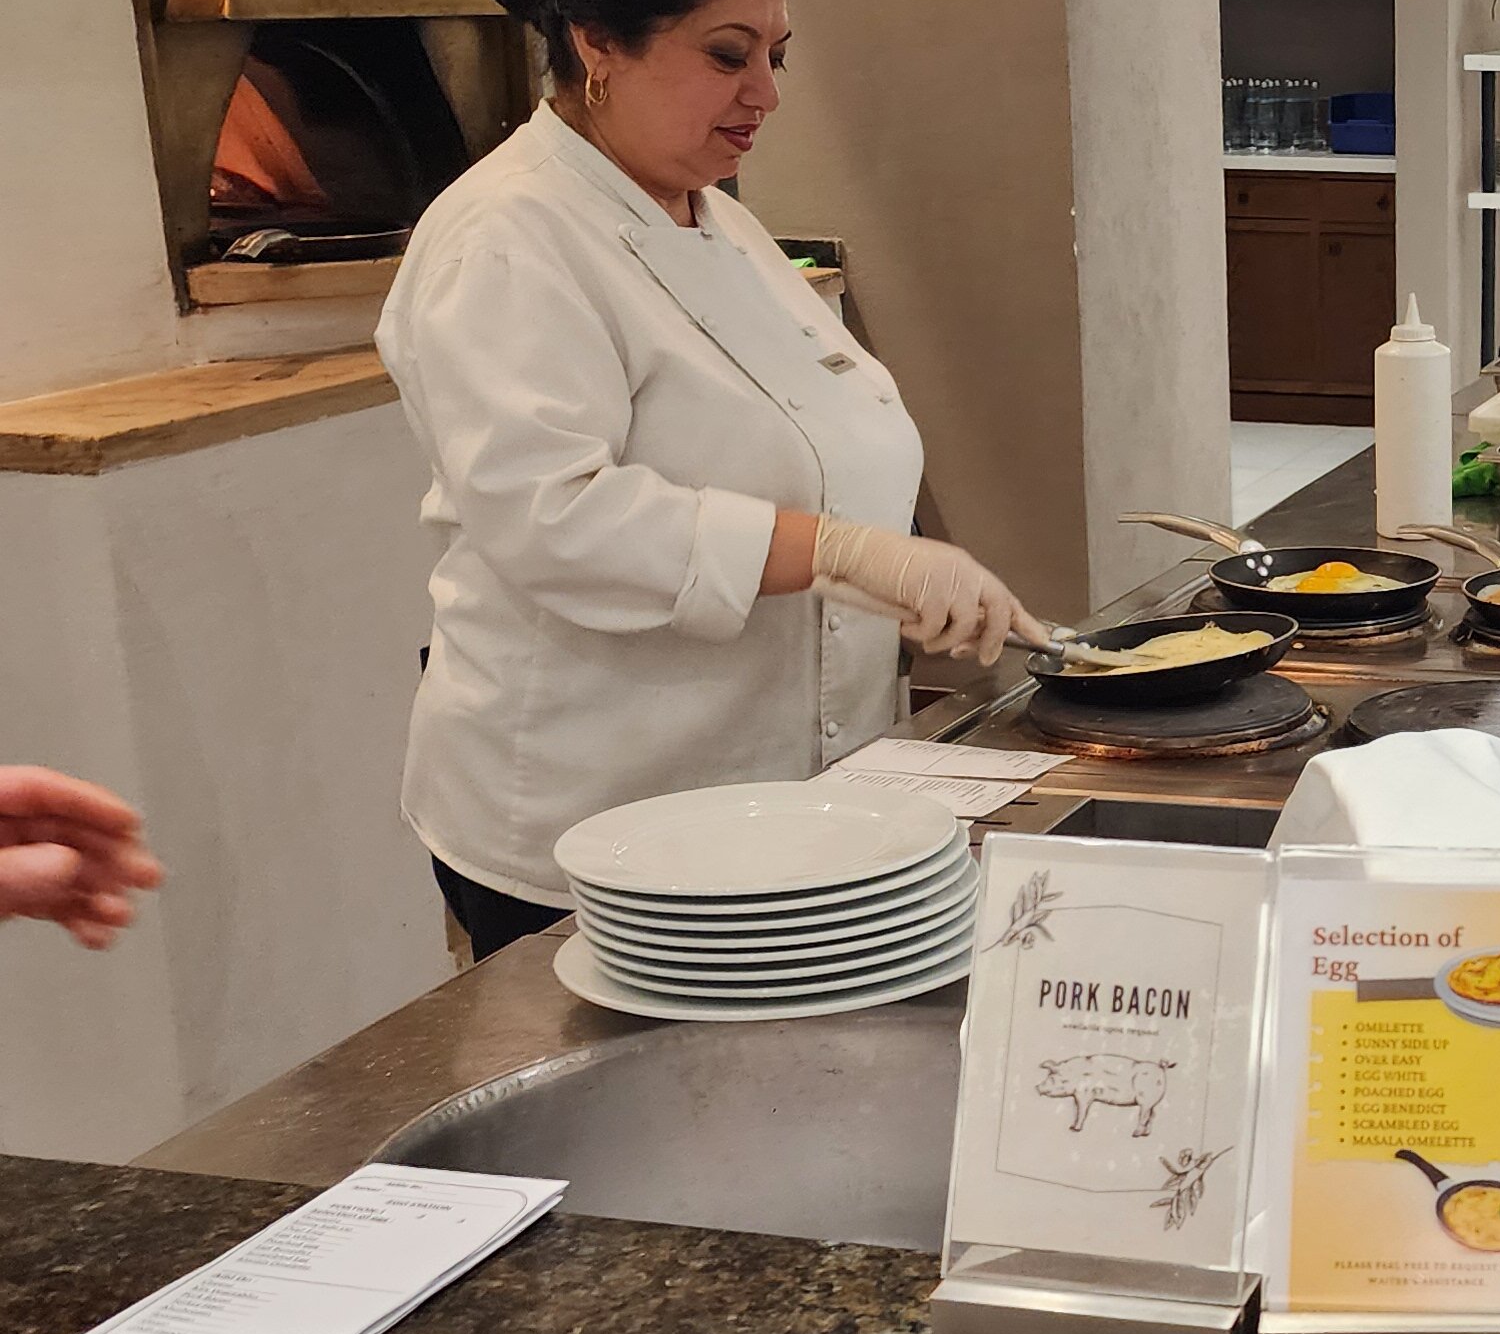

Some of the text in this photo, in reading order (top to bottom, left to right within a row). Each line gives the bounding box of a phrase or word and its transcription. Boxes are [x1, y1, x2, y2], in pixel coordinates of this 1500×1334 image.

[1312, 924, 1464, 948] Selection of
[1311, 956, 1359, 982] Egg
[1039, 978, 1191, 1019] PORK BACON
[1354, 1022, 1424, 1034] OMELETTE
[1354, 1038, 1450, 1050] SUNNY SIDE UP
[1354, 1054, 1422, 1066] OVER EASY
[1354, 1070, 1427, 1083] EGG WHITE
[1353, 1086, 1445, 1099] POACHED EGG
[1353, 1103, 1447, 1115] EGG BENEDICT
[1352, 1119, 1460, 1131] SCRAMBLED EGG
[1352, 1135, 1476, 1148] MASALA OMELETTE
